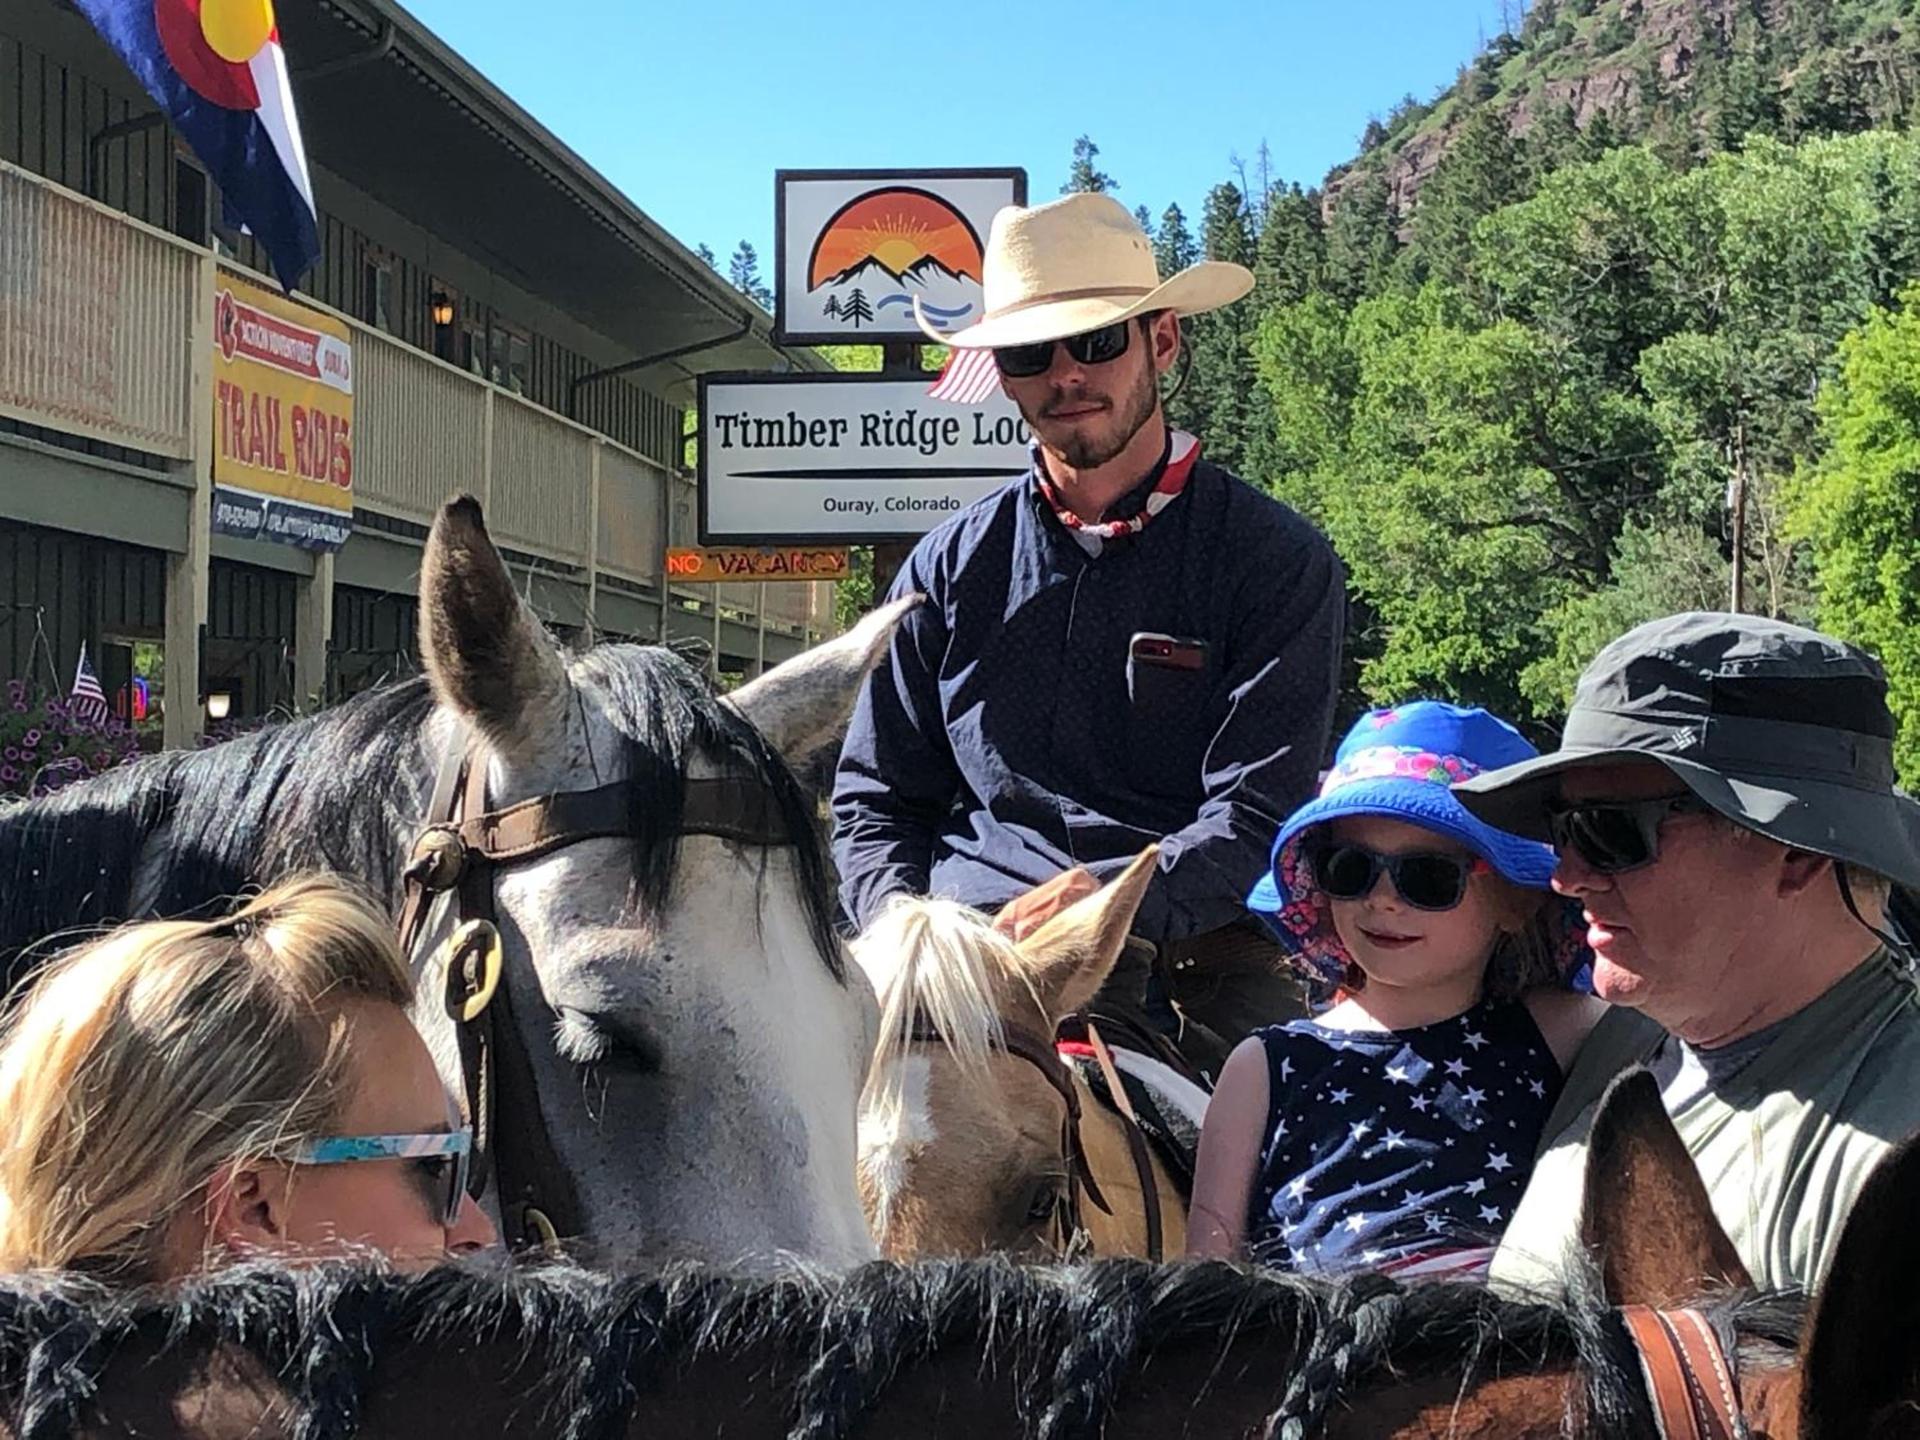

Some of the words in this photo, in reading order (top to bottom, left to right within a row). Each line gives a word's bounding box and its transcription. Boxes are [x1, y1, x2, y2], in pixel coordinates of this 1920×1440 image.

[218, 379, 289, 474] TRAIL
[291, 404, 352, 490] RIDES
[715, 411, 848, 449] Timber
[860, 409, 960, 455] Ridge
[823, 497, 879, 516] Ouray,
[884, 495, 961, 512] Colorado
[667, 553, 703, 574] NO
[711, 551, 847, 575] VACANCY
